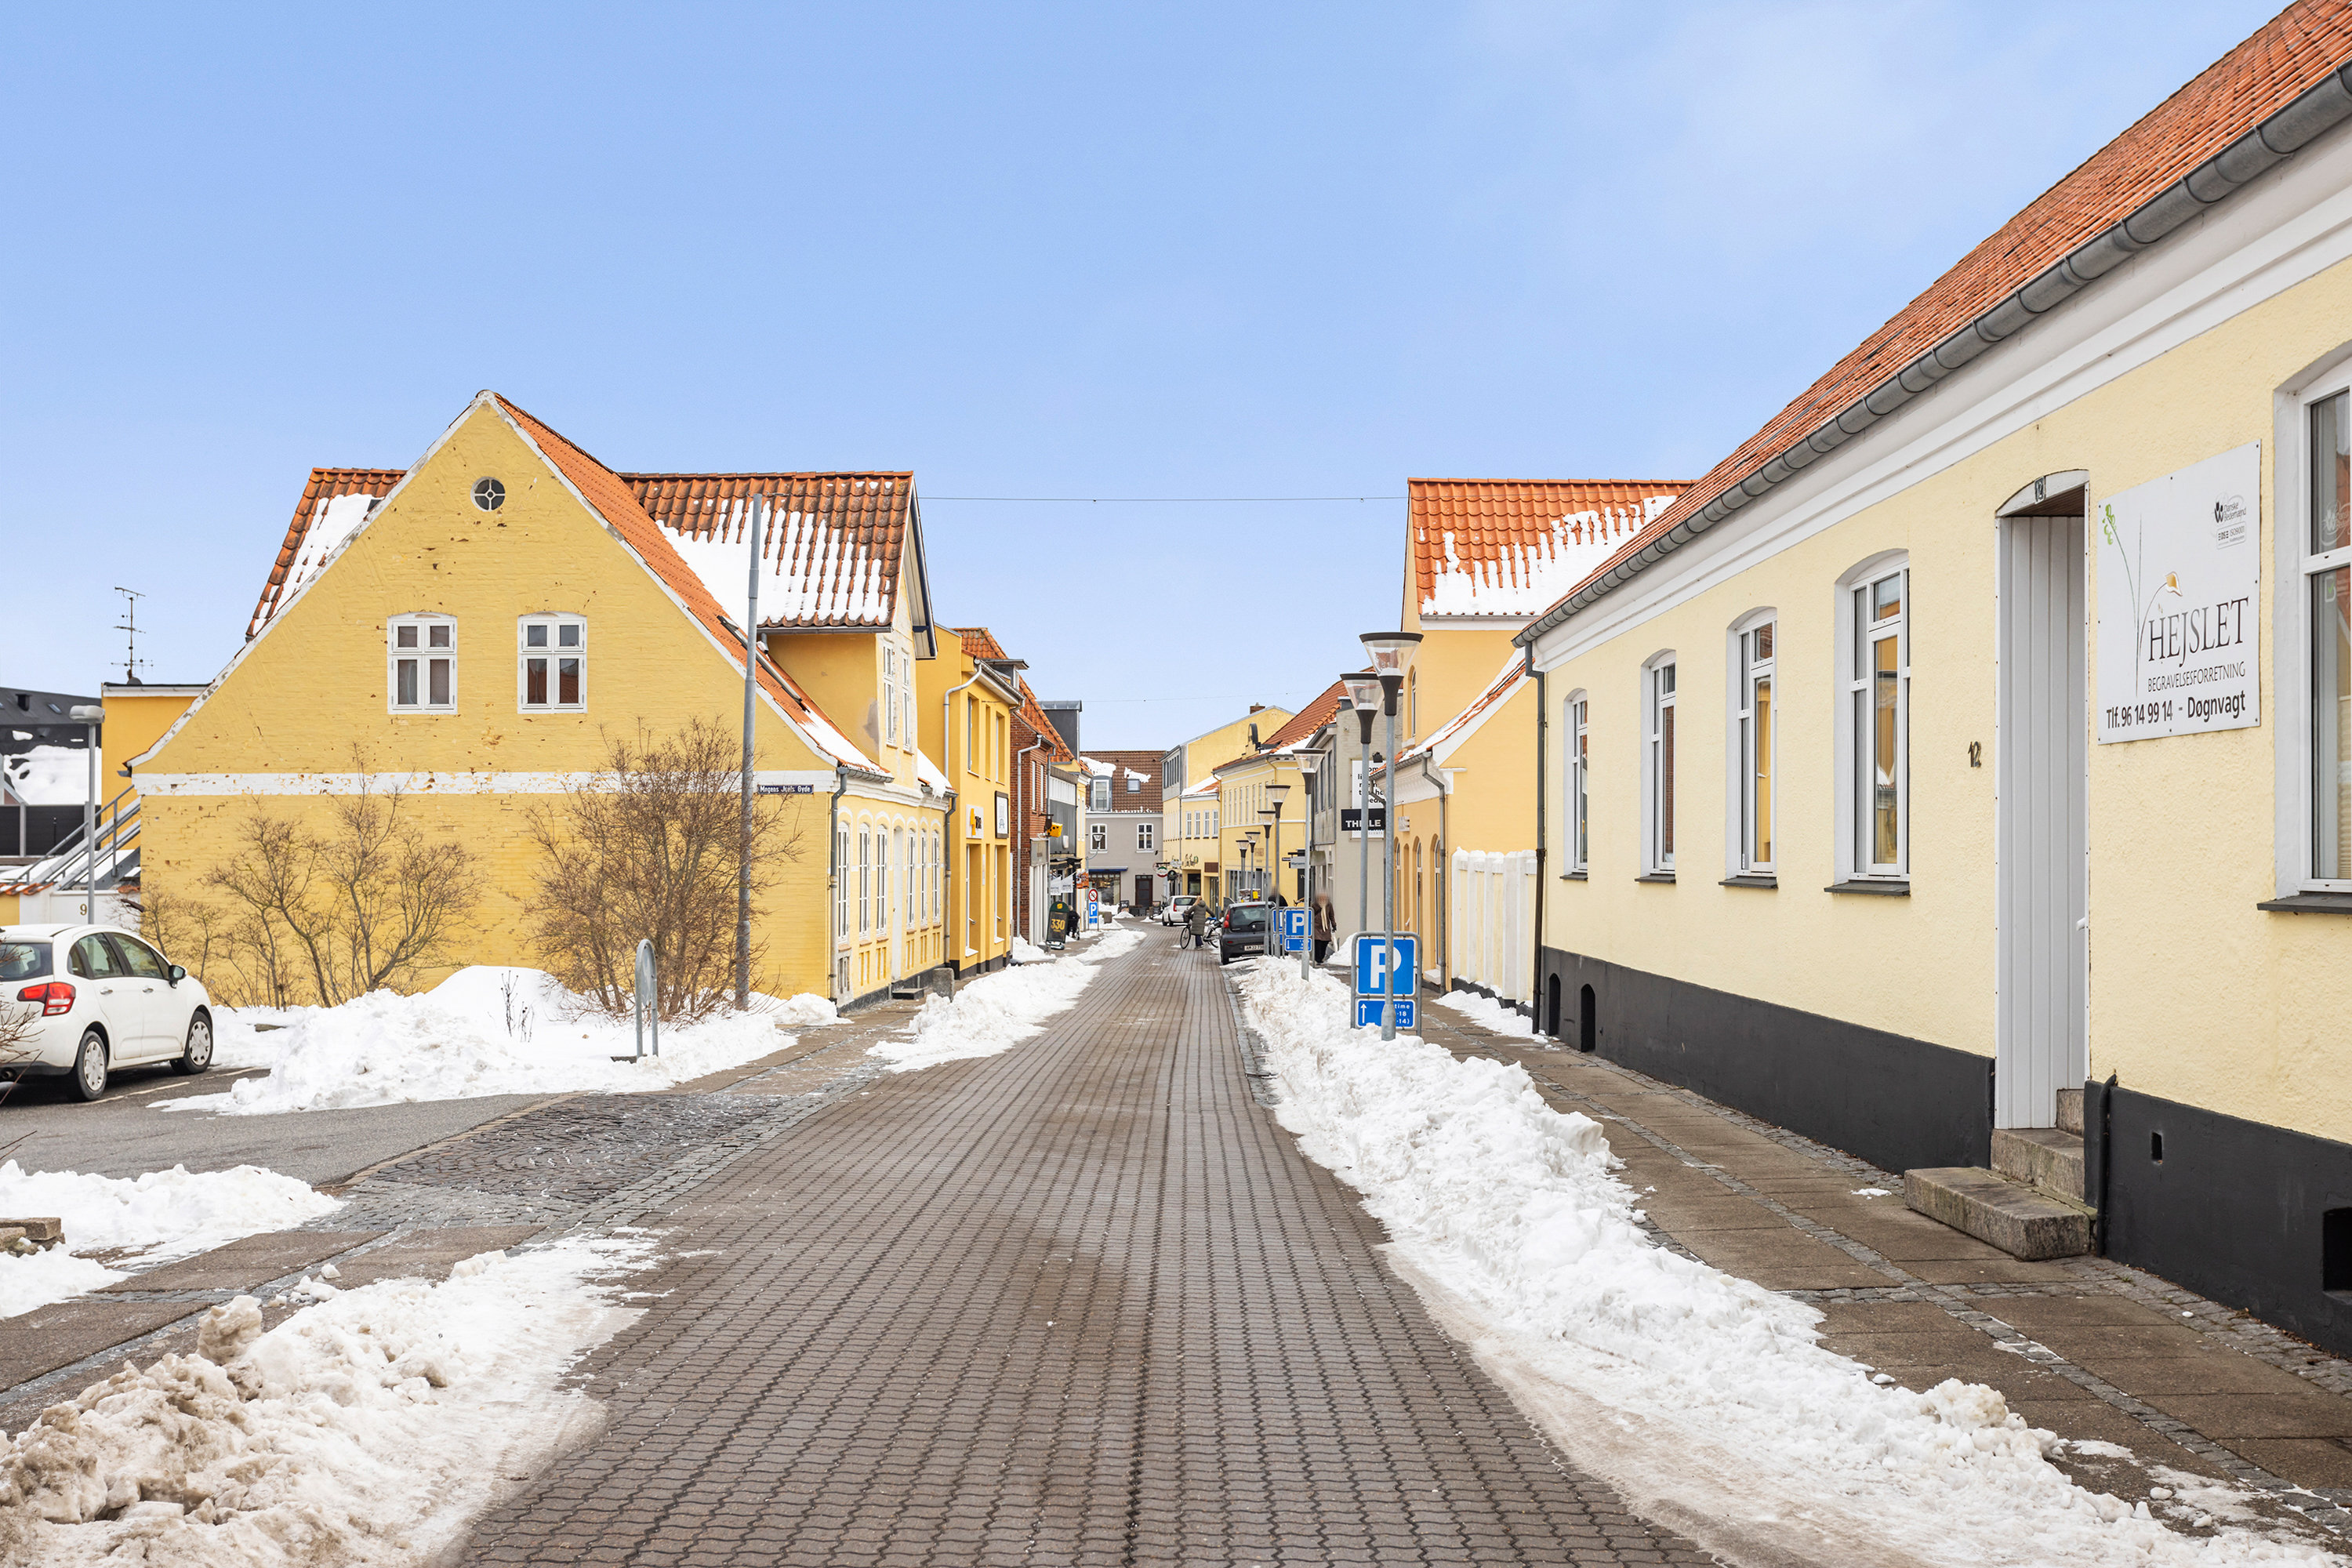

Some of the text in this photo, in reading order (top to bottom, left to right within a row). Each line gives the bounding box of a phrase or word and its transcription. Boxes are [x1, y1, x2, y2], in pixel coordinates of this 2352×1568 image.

[2224, 502, 2238, 512] Danske
[2148, 596, 2249, 667] HEJSLET
[2148, 661, 2245, 692] BEGRAVELSESFORRETNING
[2122, 706, 2132, 727] 96
[2134, 704, 2145, 725] 14
[2147, 702, 2159, 724] 99
[2161, 700, 2172, 721] 14
[2187, 690, 2245, 722] Døgnvagt
[1968, 741, 1981, 767] 12
[1345, 819, 1381, 828] THILE
[80, 903, 87, 916] 9
[1091, 904, 1096, 915] P
[1051, 918, 1065, 930] 330
[1292, 913, 1305, 933] P
[1370, 945, 1402, 988] P
